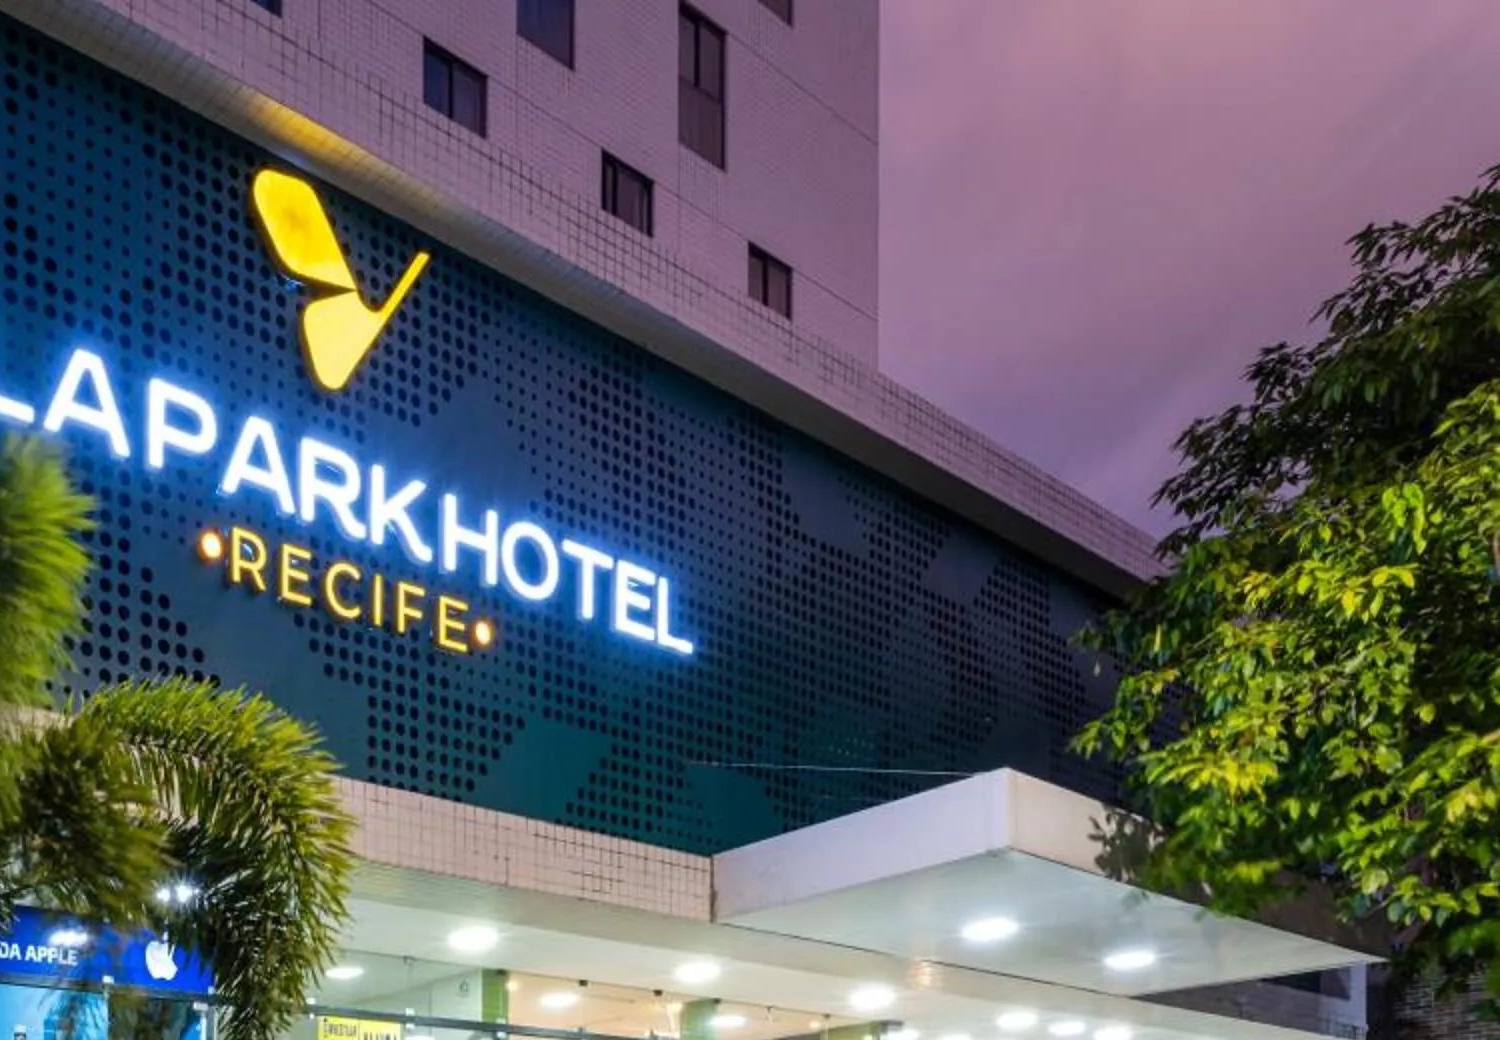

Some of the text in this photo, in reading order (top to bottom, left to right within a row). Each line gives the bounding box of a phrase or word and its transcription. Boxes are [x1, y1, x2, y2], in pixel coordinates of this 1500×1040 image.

[147, 377, 433, 563] PARK
[442, 492, 694, 655] HOTEL
[230, 526, 469, 653] RECIFE
[25, 945, 78, 966] APPLE
